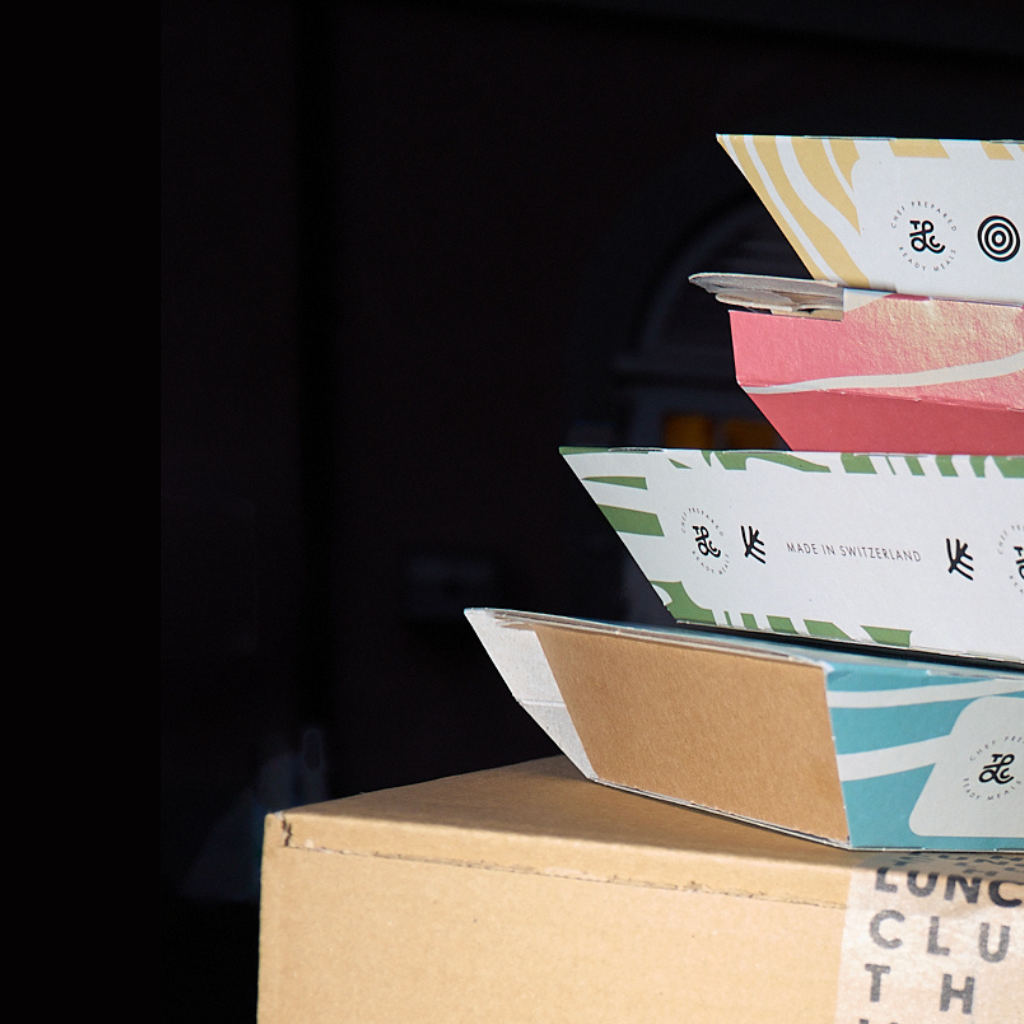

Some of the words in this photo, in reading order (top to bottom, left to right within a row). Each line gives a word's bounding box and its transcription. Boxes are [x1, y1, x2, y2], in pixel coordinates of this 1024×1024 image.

[786, 542, 819, 555] MADE
[821, 544, 835, 556] IN
[839, 545, 922, 563] SWITZERLAND
